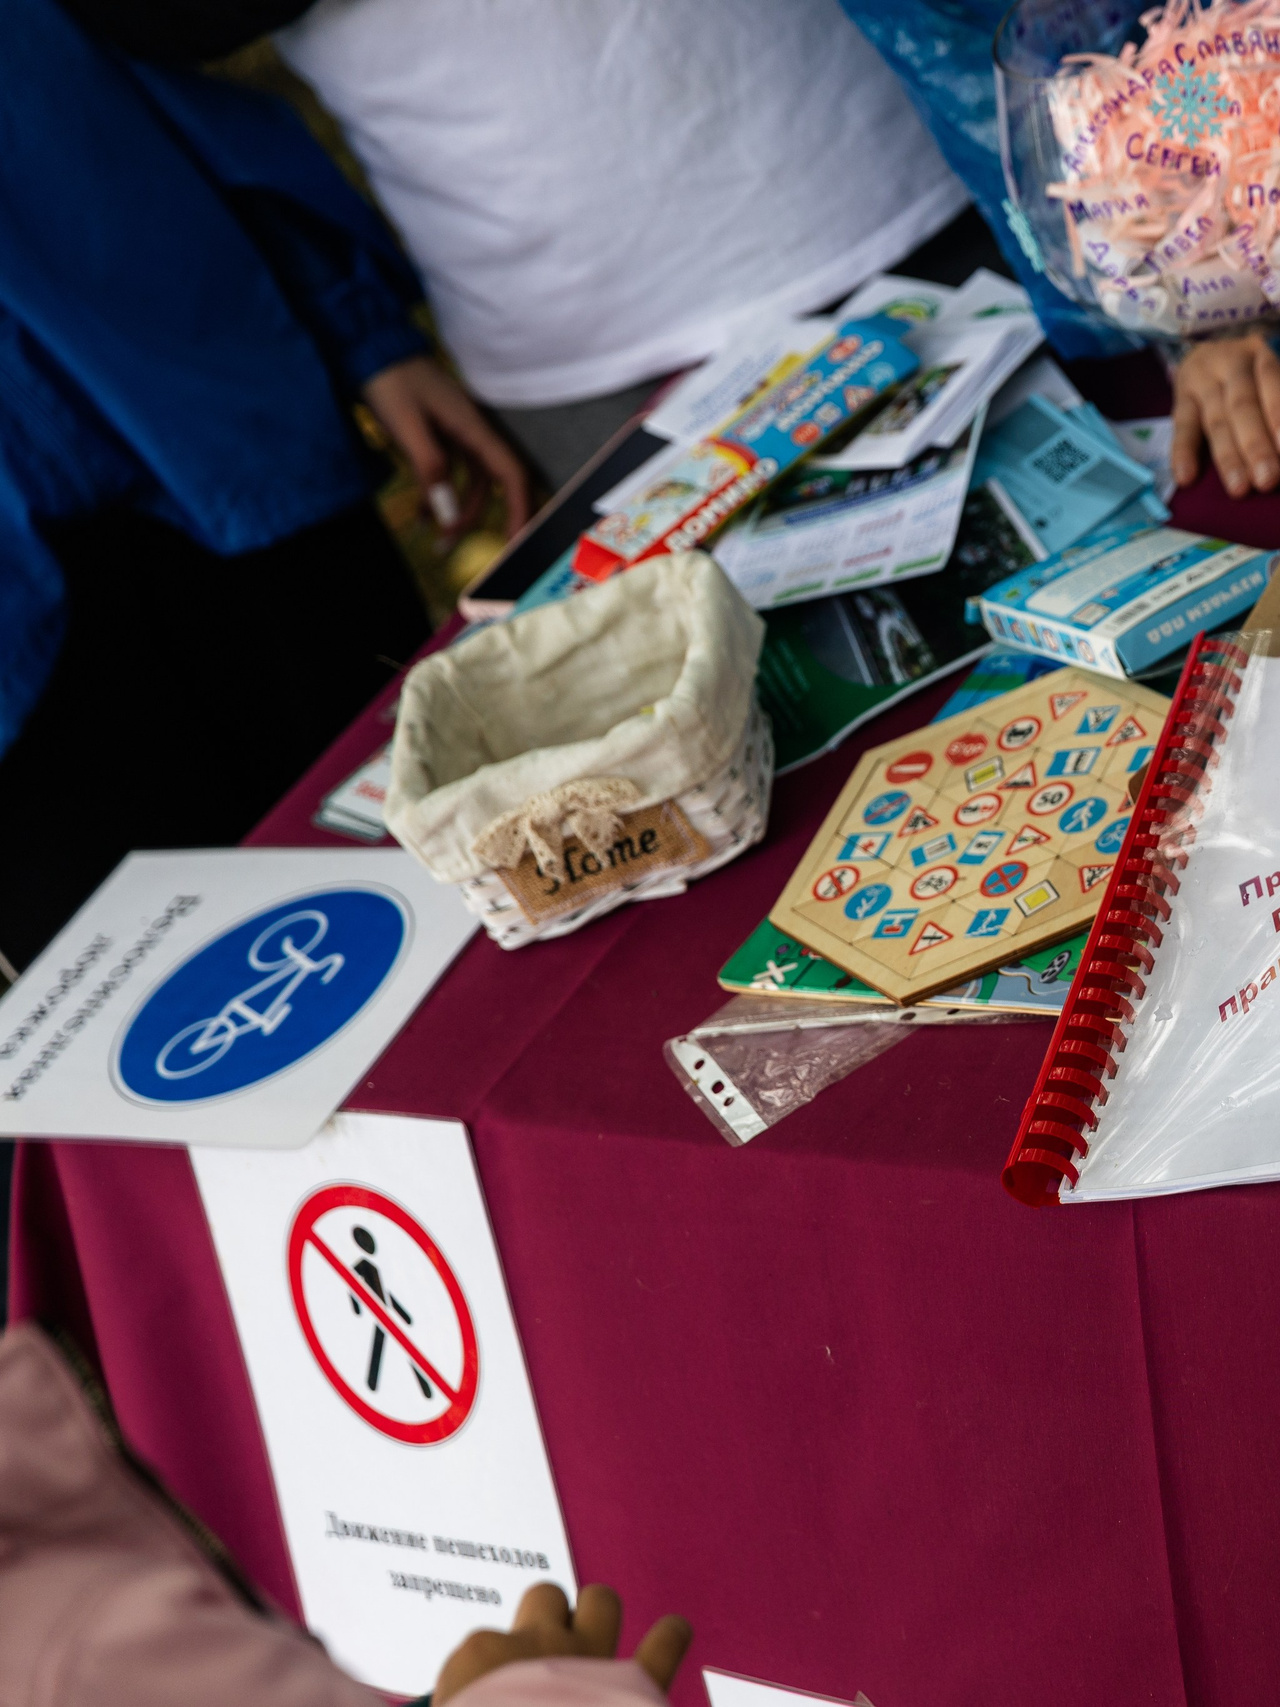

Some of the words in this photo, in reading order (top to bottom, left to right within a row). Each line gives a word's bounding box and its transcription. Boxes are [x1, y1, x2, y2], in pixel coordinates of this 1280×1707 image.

[1035, 791, 1064, 807] 50
[2, 895, 202, 1101] Велосипедная
[325, 1511, 427, 1551] Движение
[433, 1535, 551, 1571] пешеходов
[388, 1569, 503, 1606] запрещено
